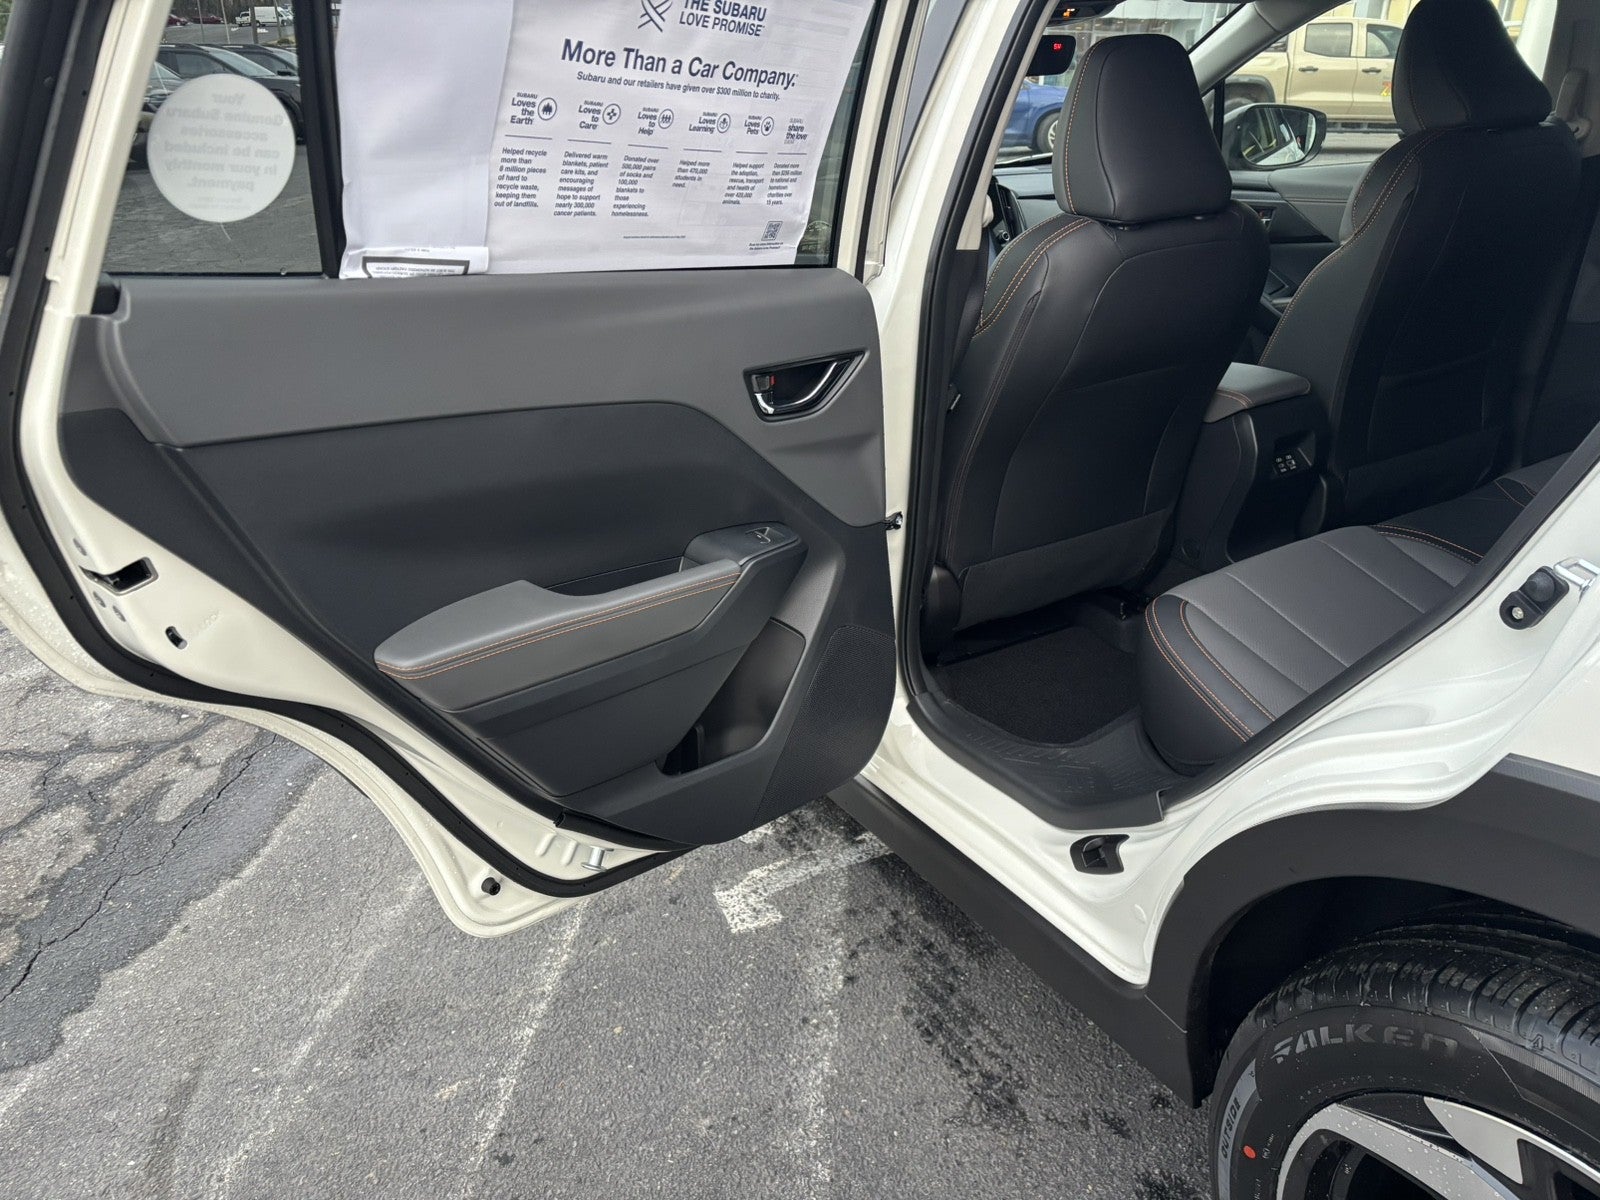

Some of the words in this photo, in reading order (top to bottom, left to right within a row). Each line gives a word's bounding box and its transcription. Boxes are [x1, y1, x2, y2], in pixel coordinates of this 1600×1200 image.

[682, 0, 709, 12] THE
[712, 0, 767, 22] SUBARU
[679, 12, 709, 28] LOVE
[712, 17, 763, 37] PROMISE
[561, 38, 616, 68] More
[623, 47, 666, 74] Than
[671, 59, 683, 75] a
[689, 57, 720, 79] Car
[722, 61, 797, 90] Company.
[576, 71, 606, 84] Subaru
[607, 75, 622, 86] and
[623, 77, 636, 87] our
[637, 78, 665, 90] retailers
[665, 81, 681, 91] have
[682, 82, 700, 94] given
[701, 85, 716, 95] over
[716, 86, 731, 96] $300
[731, 87, 751, 98] million
[752, 89, 759, 98] to
[760, 90, 780, 101] charity.
[511, 98, 536, 108] Loves
[521, 107, 535, 116] the
[578, 105, 601, 115] Loves
[510, 115, 533, 125] Earth
[637, 111, 657, 121] Loves
[698, 116, 716, 125] Loves
[579, 121, 598, 130] Care
[744, 120, 760, 128] Loves
[788, 124, 805, 132] share
[638, 127, 654, 136] Help
[689, 124, 716, 134] Learning
[746, 127, 759, 135] Pets
[786, 131, 795, 140] the
[796, 131, 808, 141] love
[502, 147, 525, 156] Helped
[525, 149, 547, 158] recycle
[564, 151, 591, 159] Delivered
[624, 155, 647, 163] Donated
[505, 165, 526, 173] million
[562, 160, 587, 168] blankets,
[587, 161, 609, 169] patient
[496, 183, 519, 191] recycle
[495, 192, 519, 200] keeping
